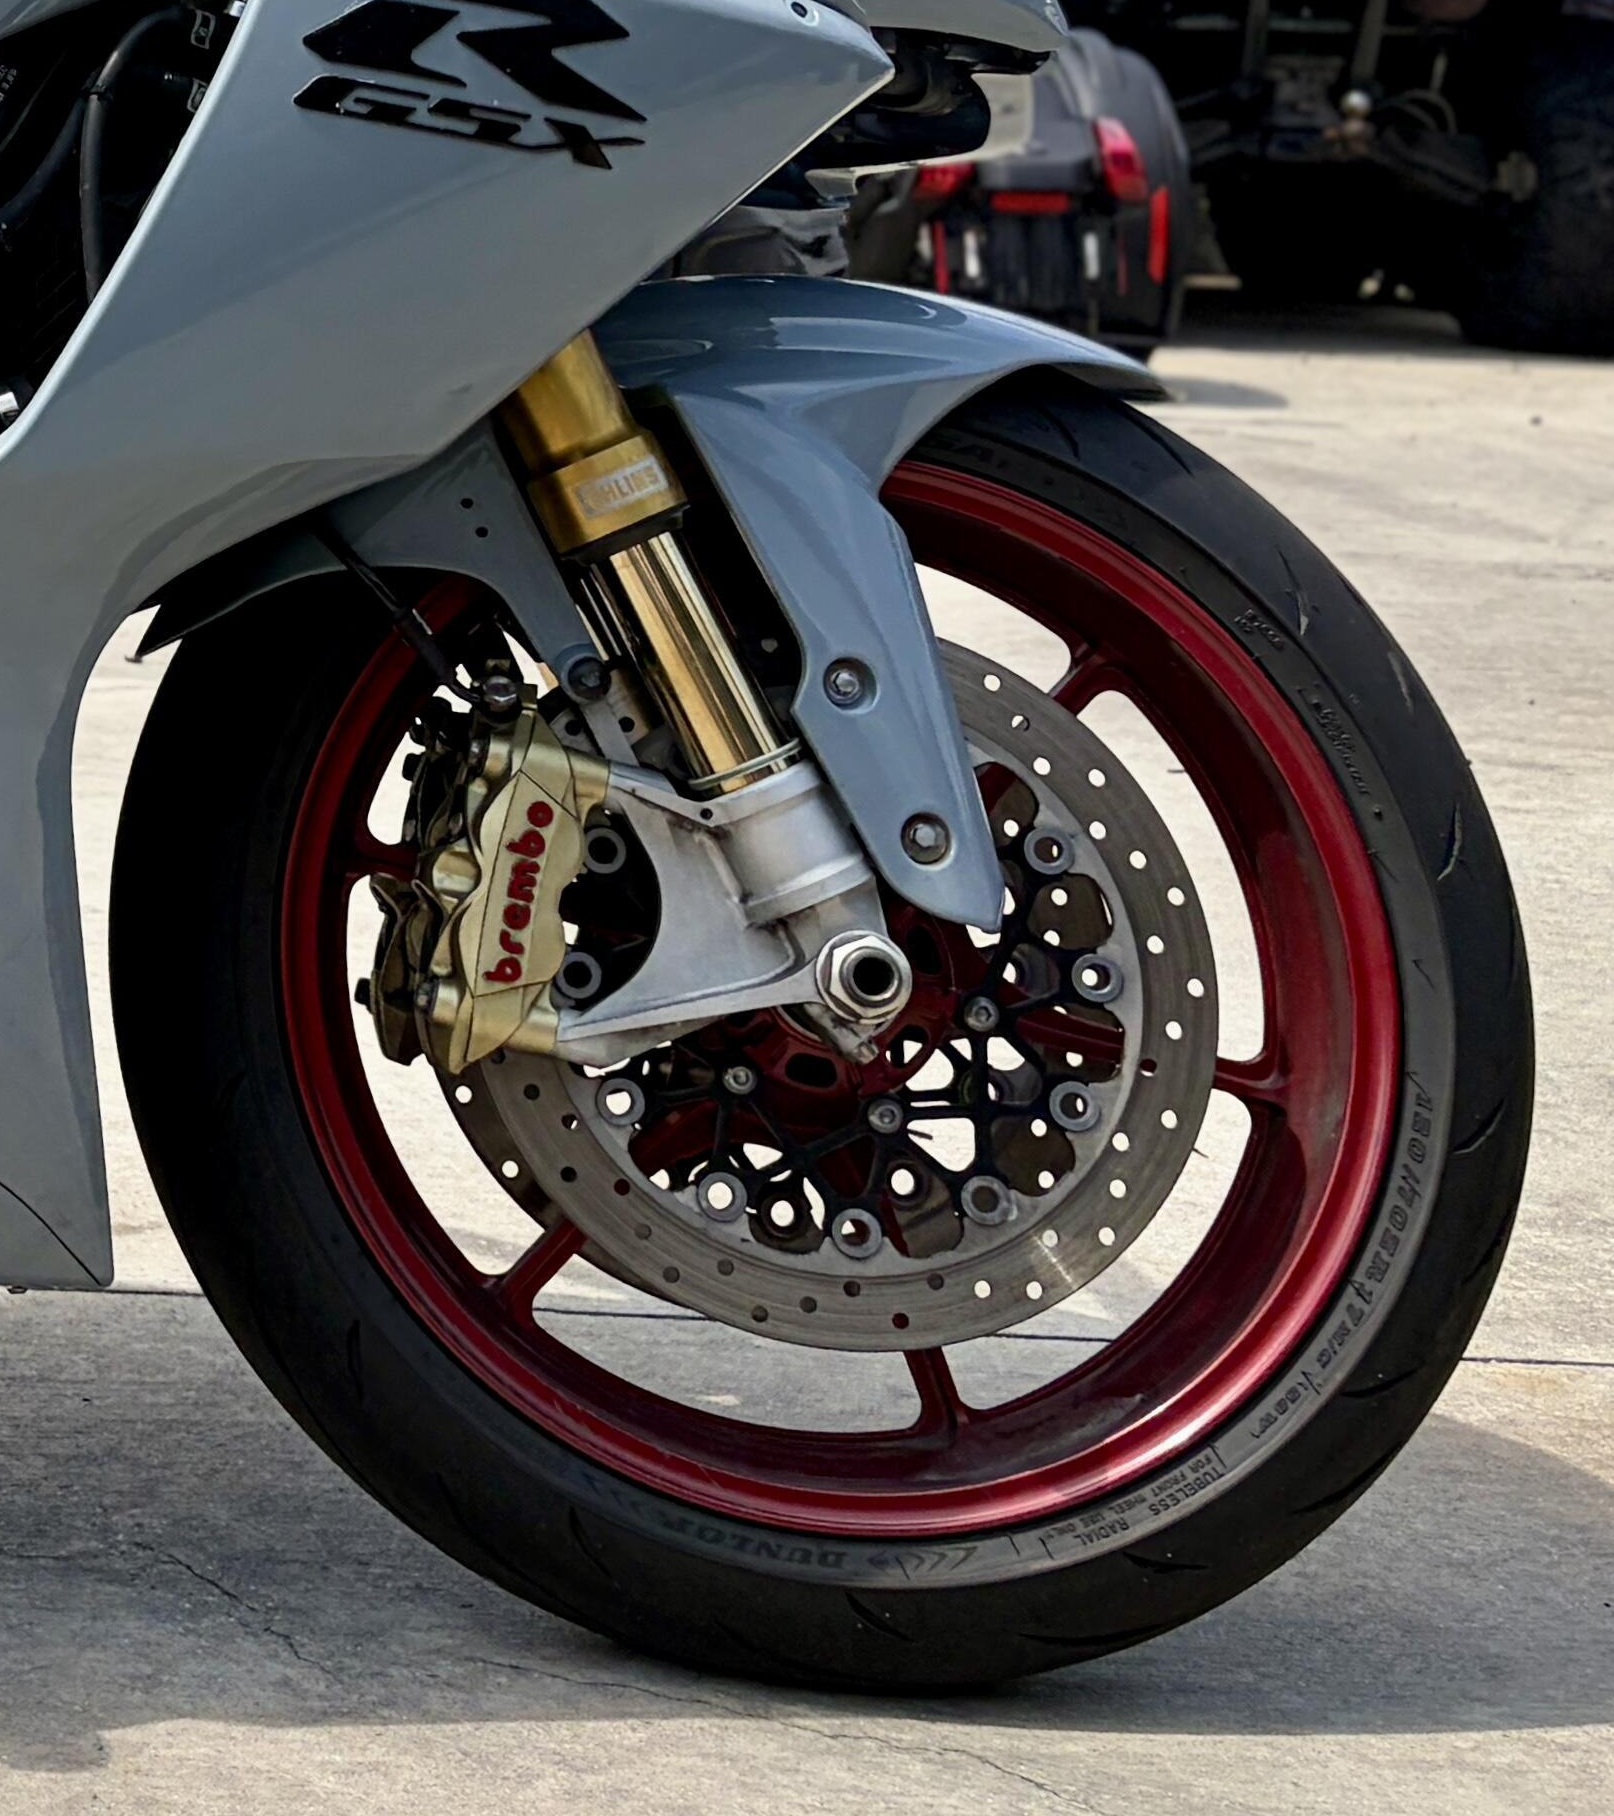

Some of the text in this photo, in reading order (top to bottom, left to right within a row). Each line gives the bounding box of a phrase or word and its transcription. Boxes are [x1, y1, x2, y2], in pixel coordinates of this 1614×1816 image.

[482, 800, 554, 983] brembo
[651, 1512, 846, 1569] DUNLOP
[1071, 1462, 1225, 1550] TUBELESS RADIAL
